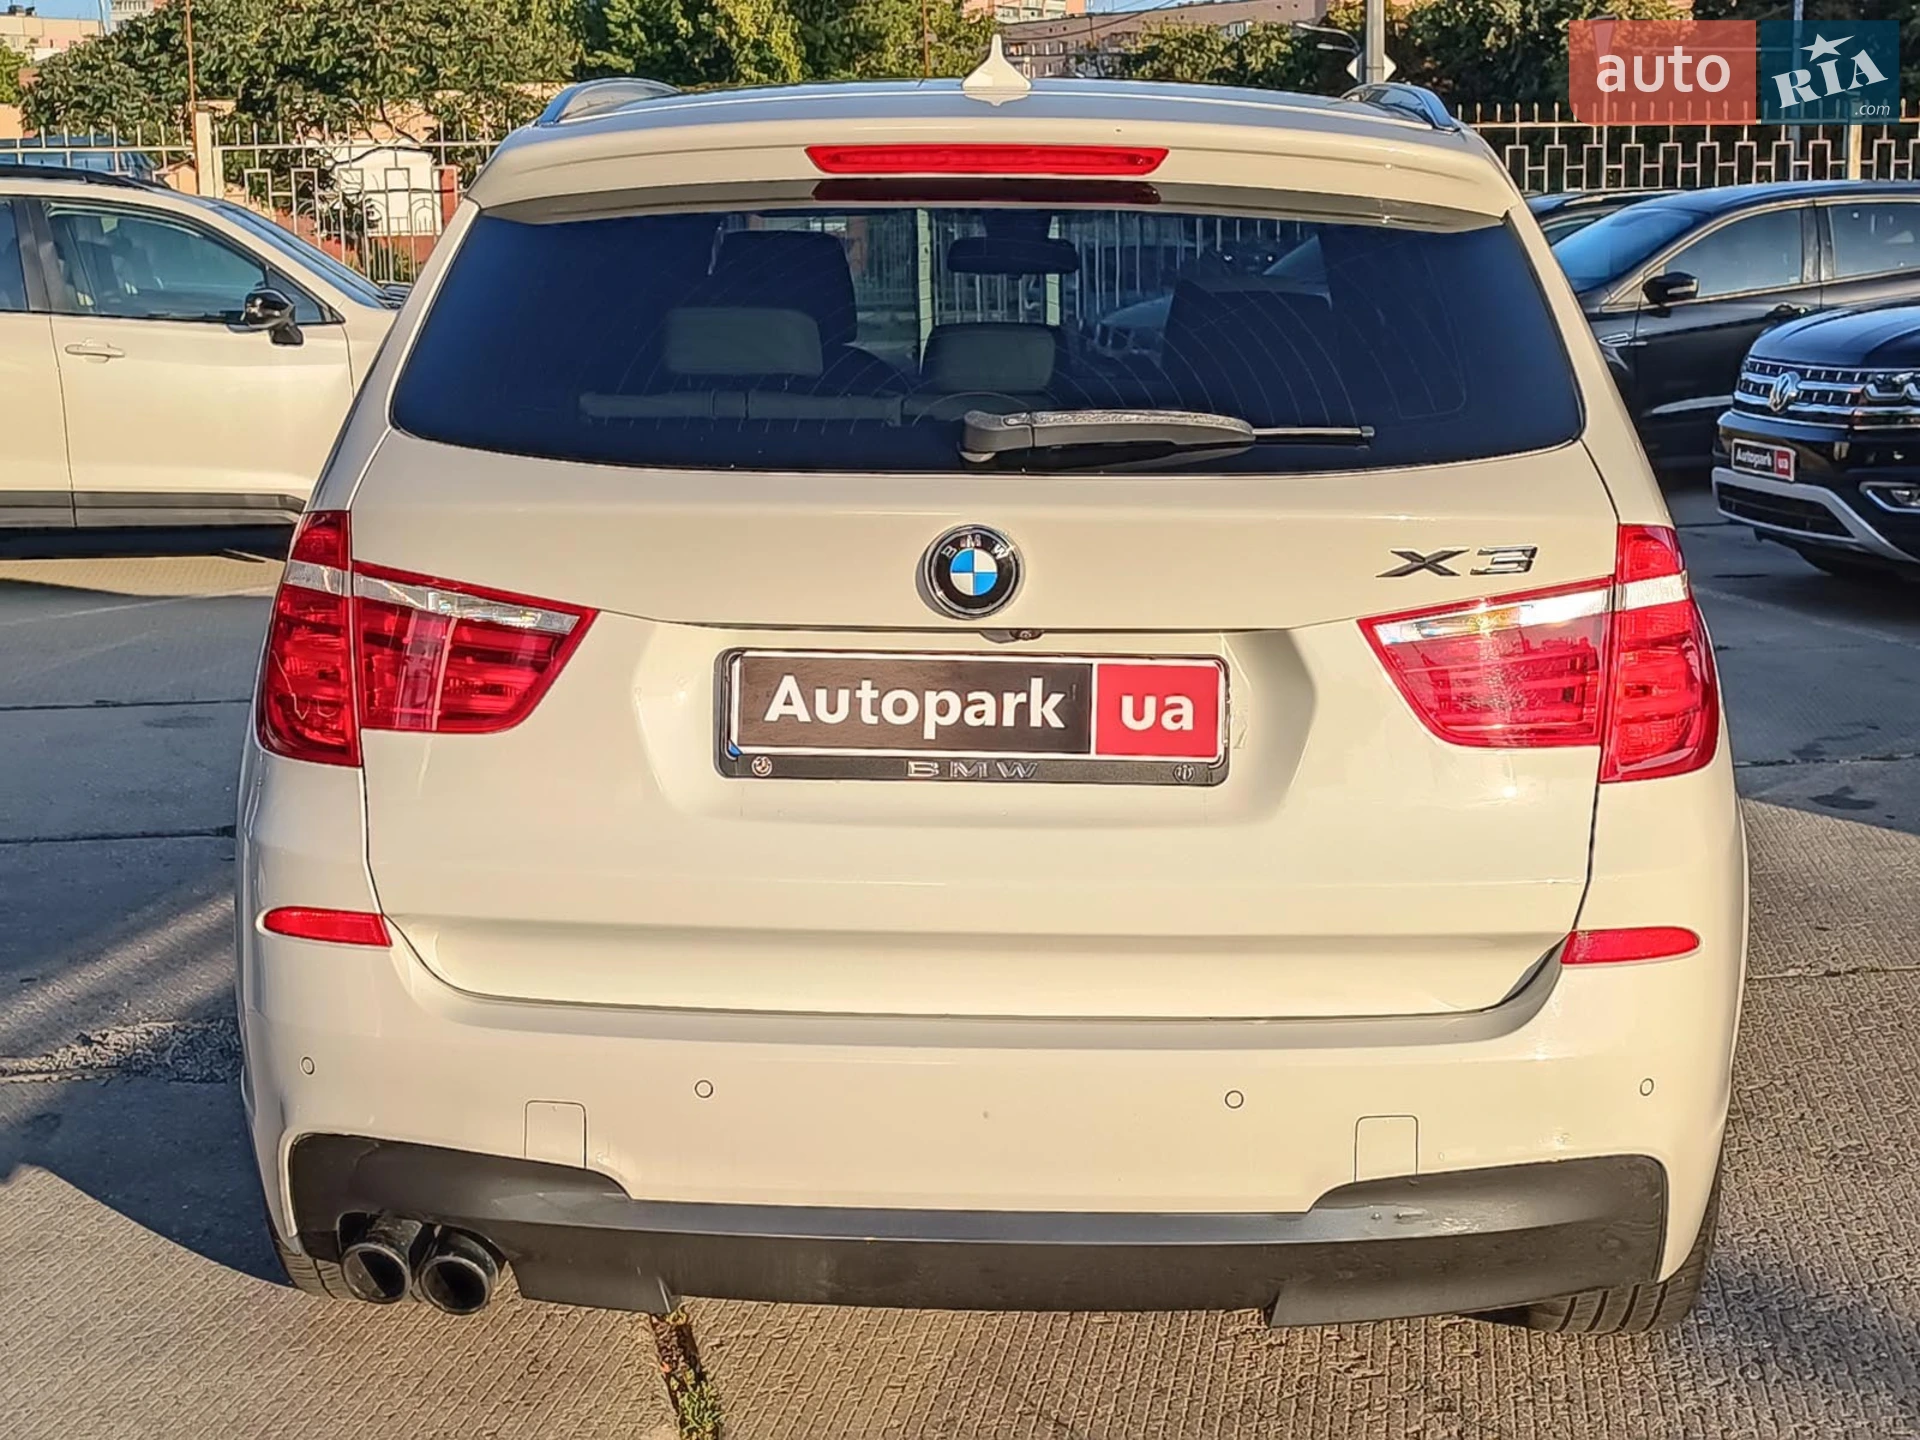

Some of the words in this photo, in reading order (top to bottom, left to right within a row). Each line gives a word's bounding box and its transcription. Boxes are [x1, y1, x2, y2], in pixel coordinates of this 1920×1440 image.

[941, 533, 1013, 560] BMW
[1375, 546, 1538, 578] X3
[764, 674, 1066, 740] Autopark
[1120, 692, 1195, 732] ua
[907, 760, 1038, 780] BMW
